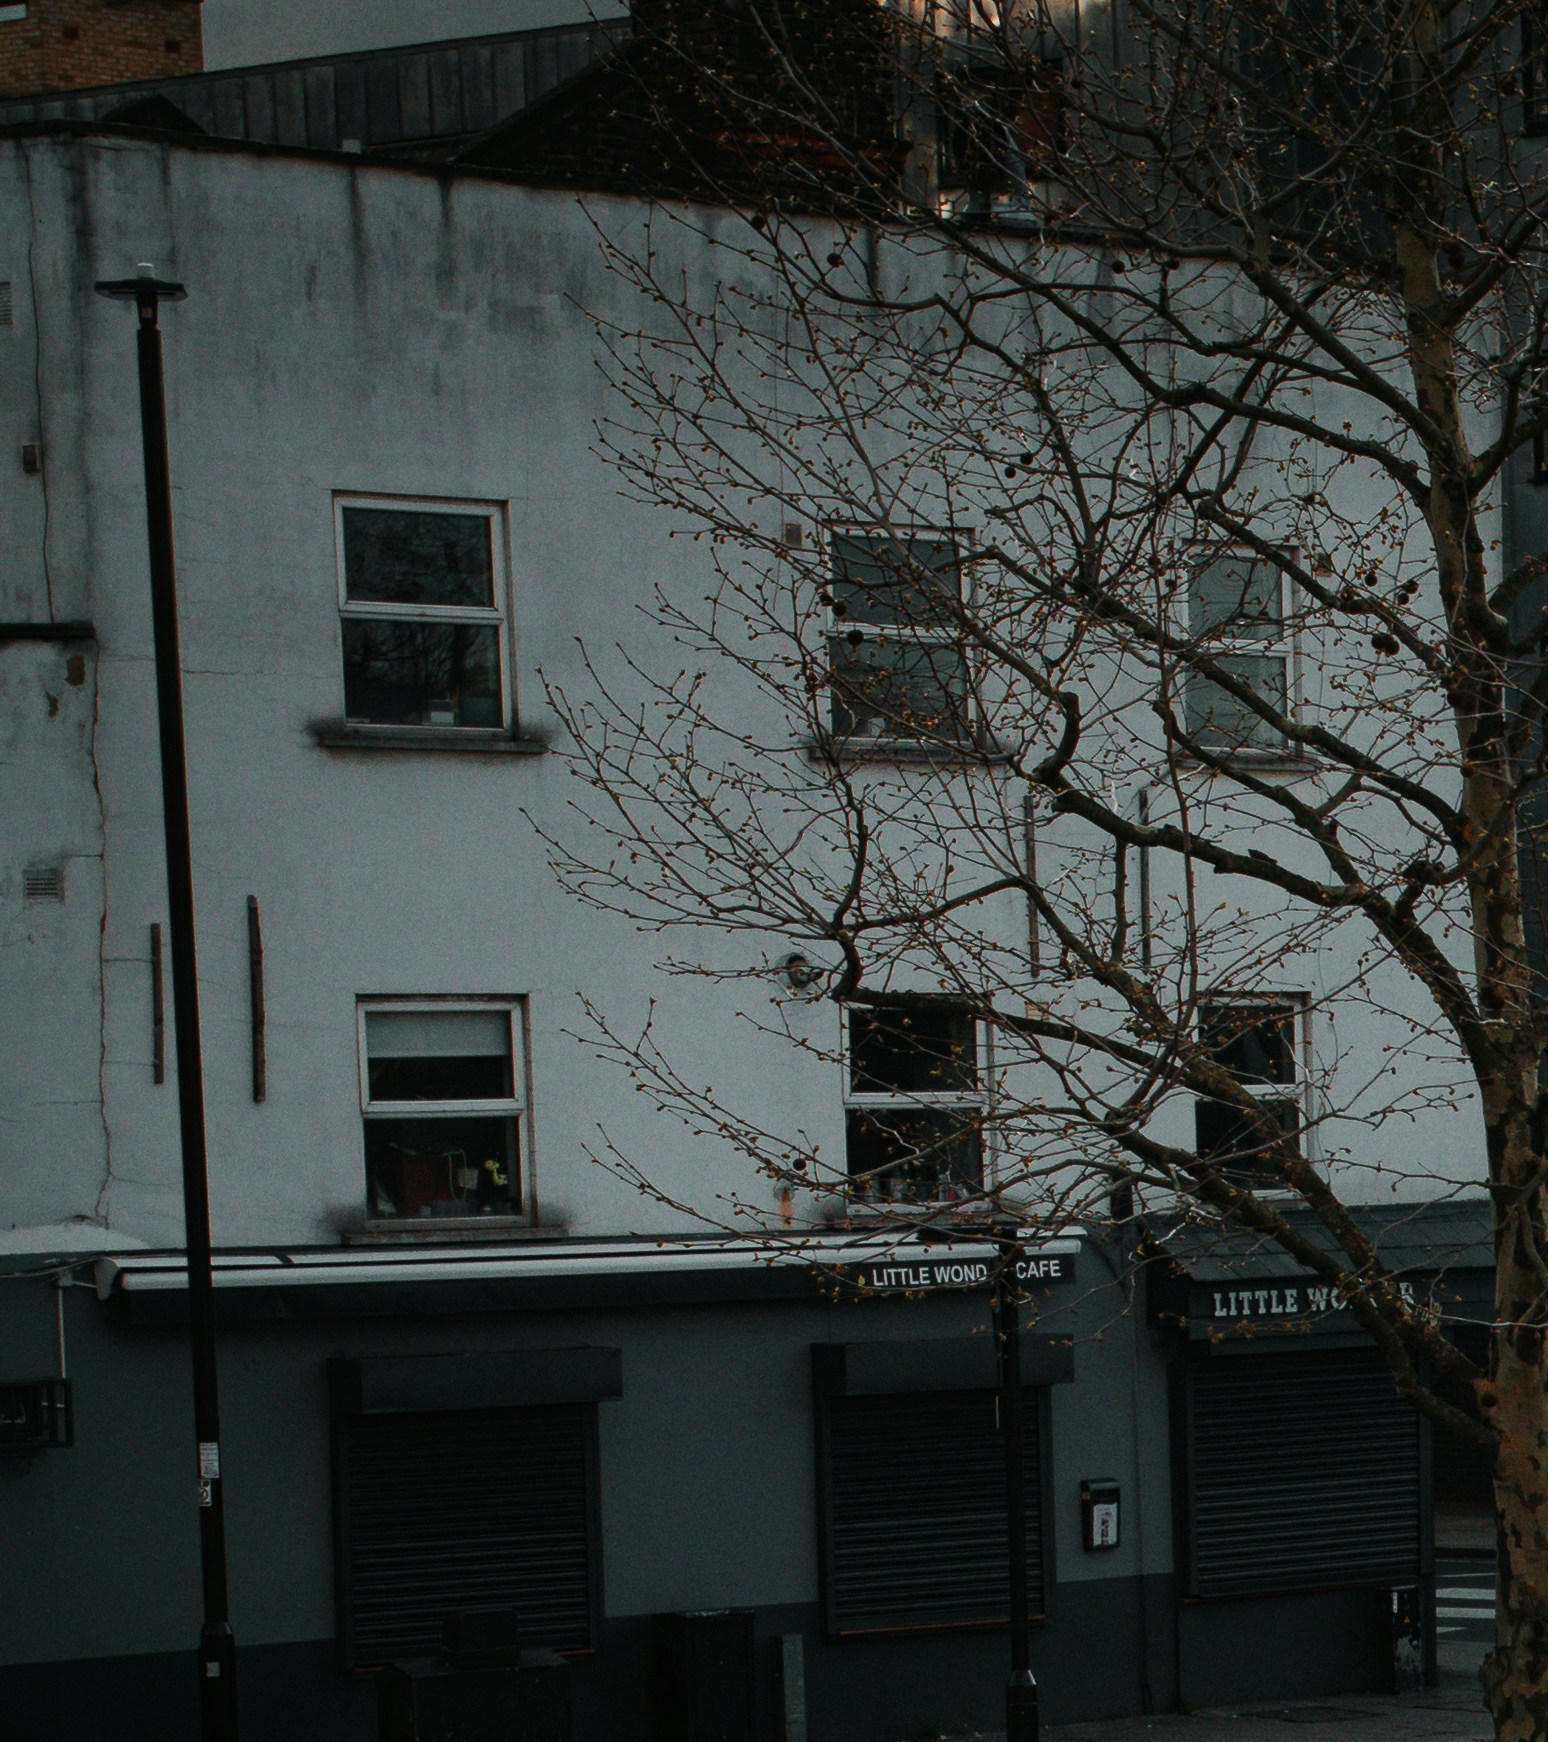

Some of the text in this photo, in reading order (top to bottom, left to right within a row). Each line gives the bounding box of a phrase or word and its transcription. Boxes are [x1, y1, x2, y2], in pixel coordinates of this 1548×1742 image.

[873, 1259, 1062, 1287] LITTLE WOND CAFE
[1213, 1288, 1299, 1318] LITTLE
